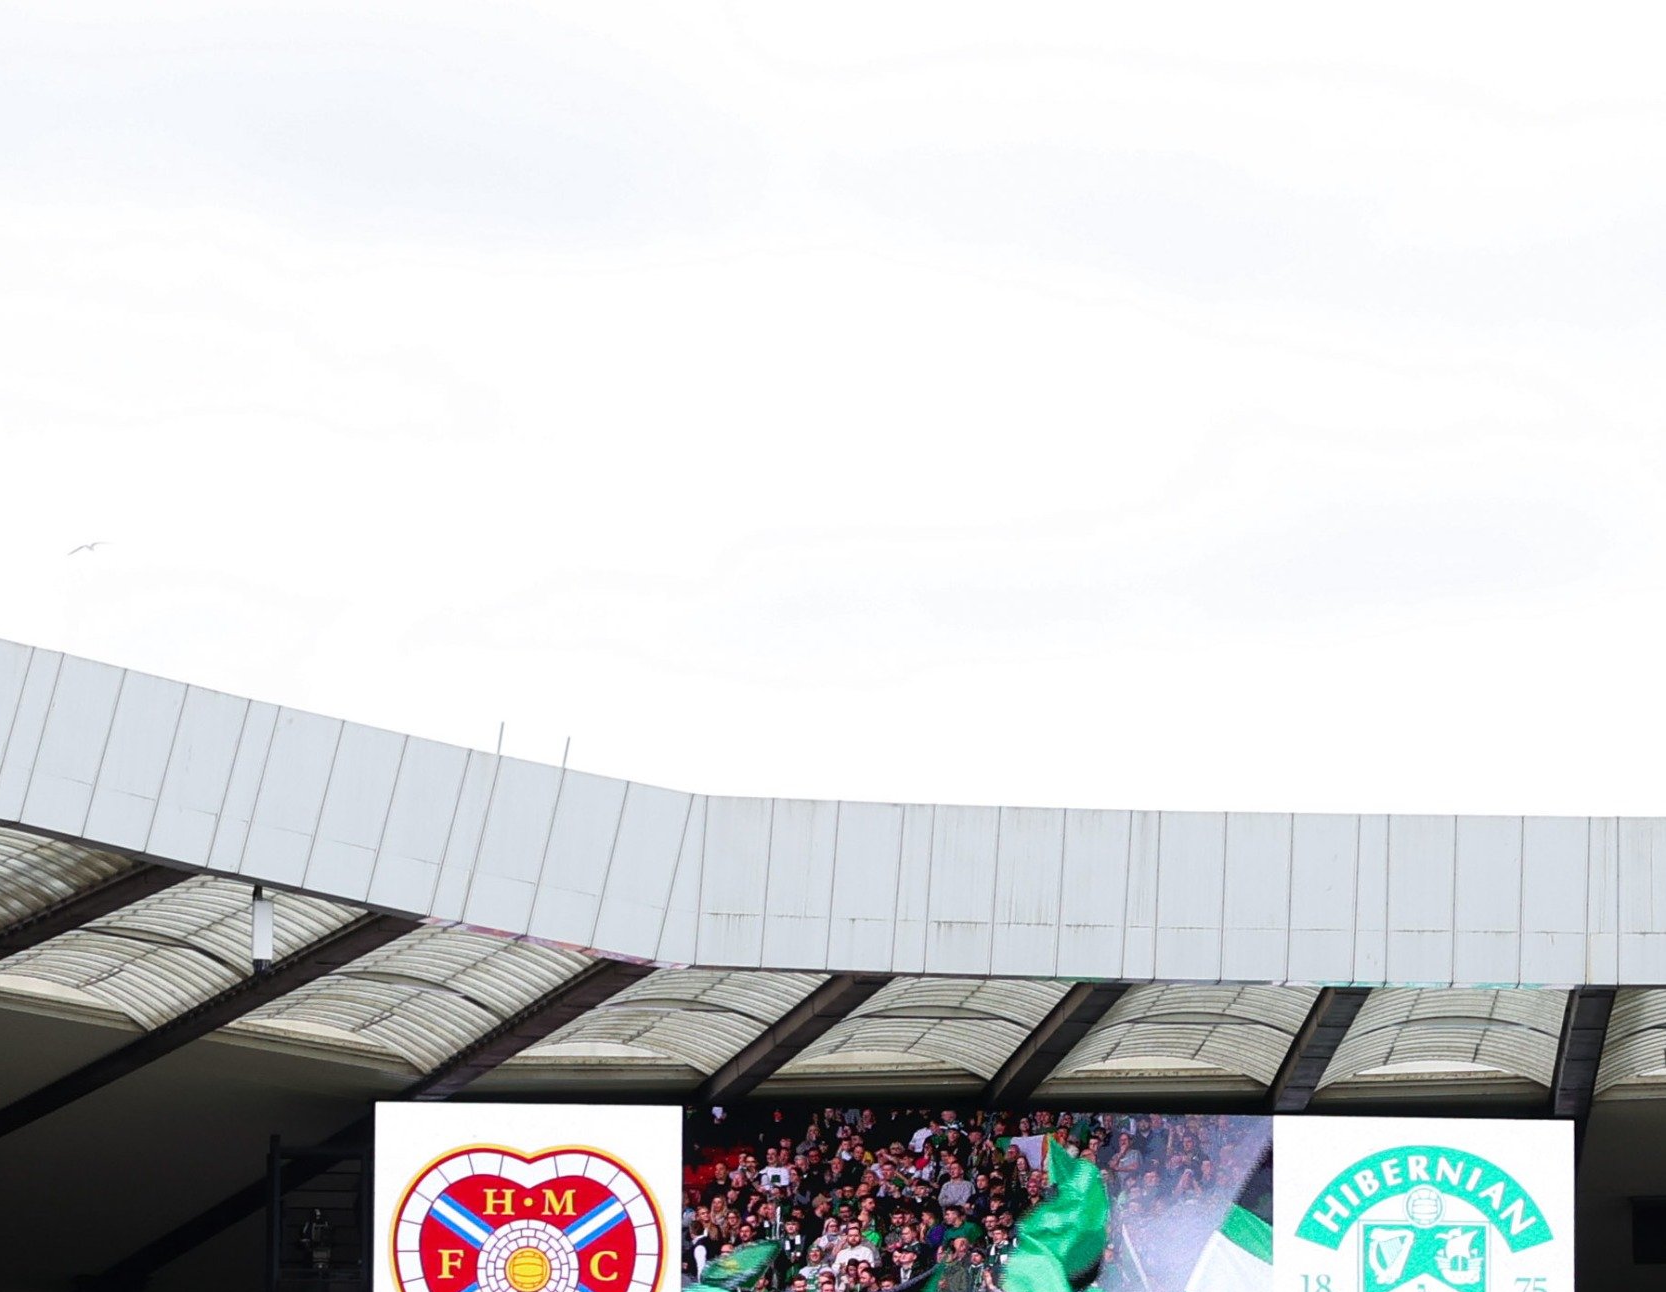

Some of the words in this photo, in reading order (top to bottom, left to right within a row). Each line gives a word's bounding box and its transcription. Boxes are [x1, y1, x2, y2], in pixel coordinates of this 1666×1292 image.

[1312, 1154, 1538, 1237] HIBERNIAN
[436, 1249, 465, 1279] F
[589, 1250, 619, 1281] C
